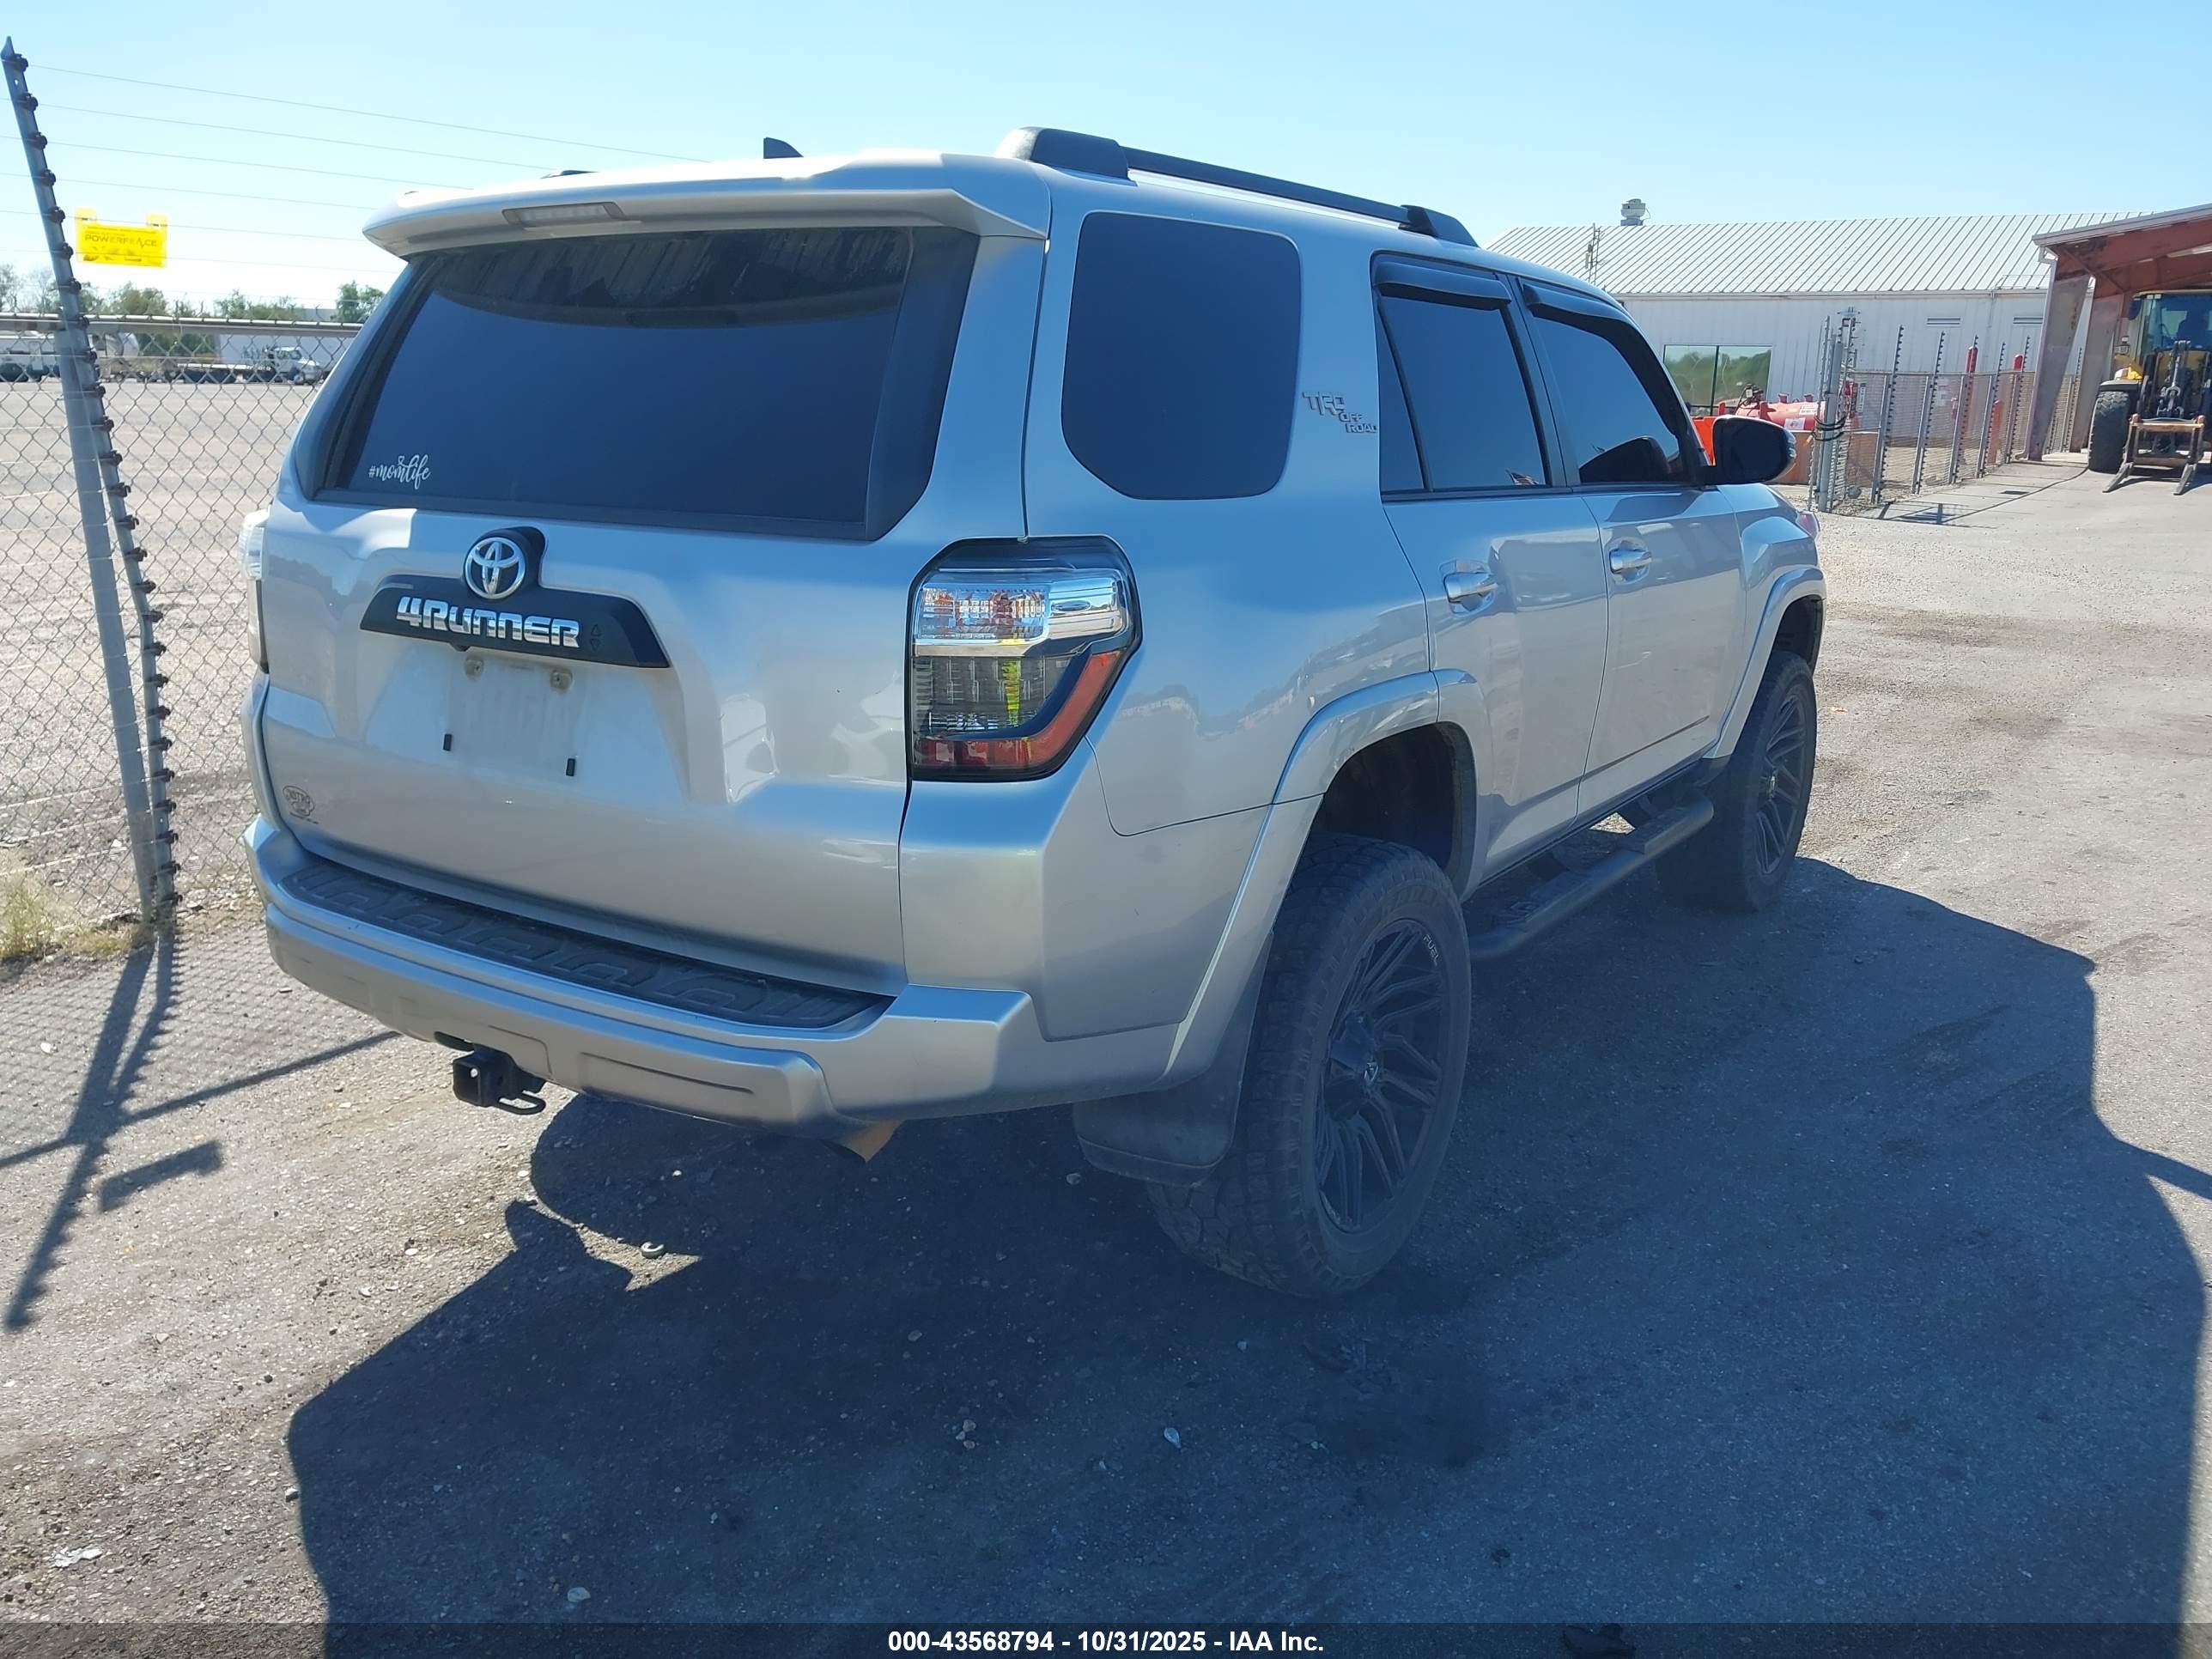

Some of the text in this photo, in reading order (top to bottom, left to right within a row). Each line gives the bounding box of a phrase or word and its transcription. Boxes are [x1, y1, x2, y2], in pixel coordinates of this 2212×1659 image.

[1338, 411, 1363, 423] OFF
[1345, 422, 1378, 433] ROAD
[368, 454, 431, 489] #momlife
[396, 596, 580, 648] 4RUNNER
[1423, 933, 1439, 967] FUEL
